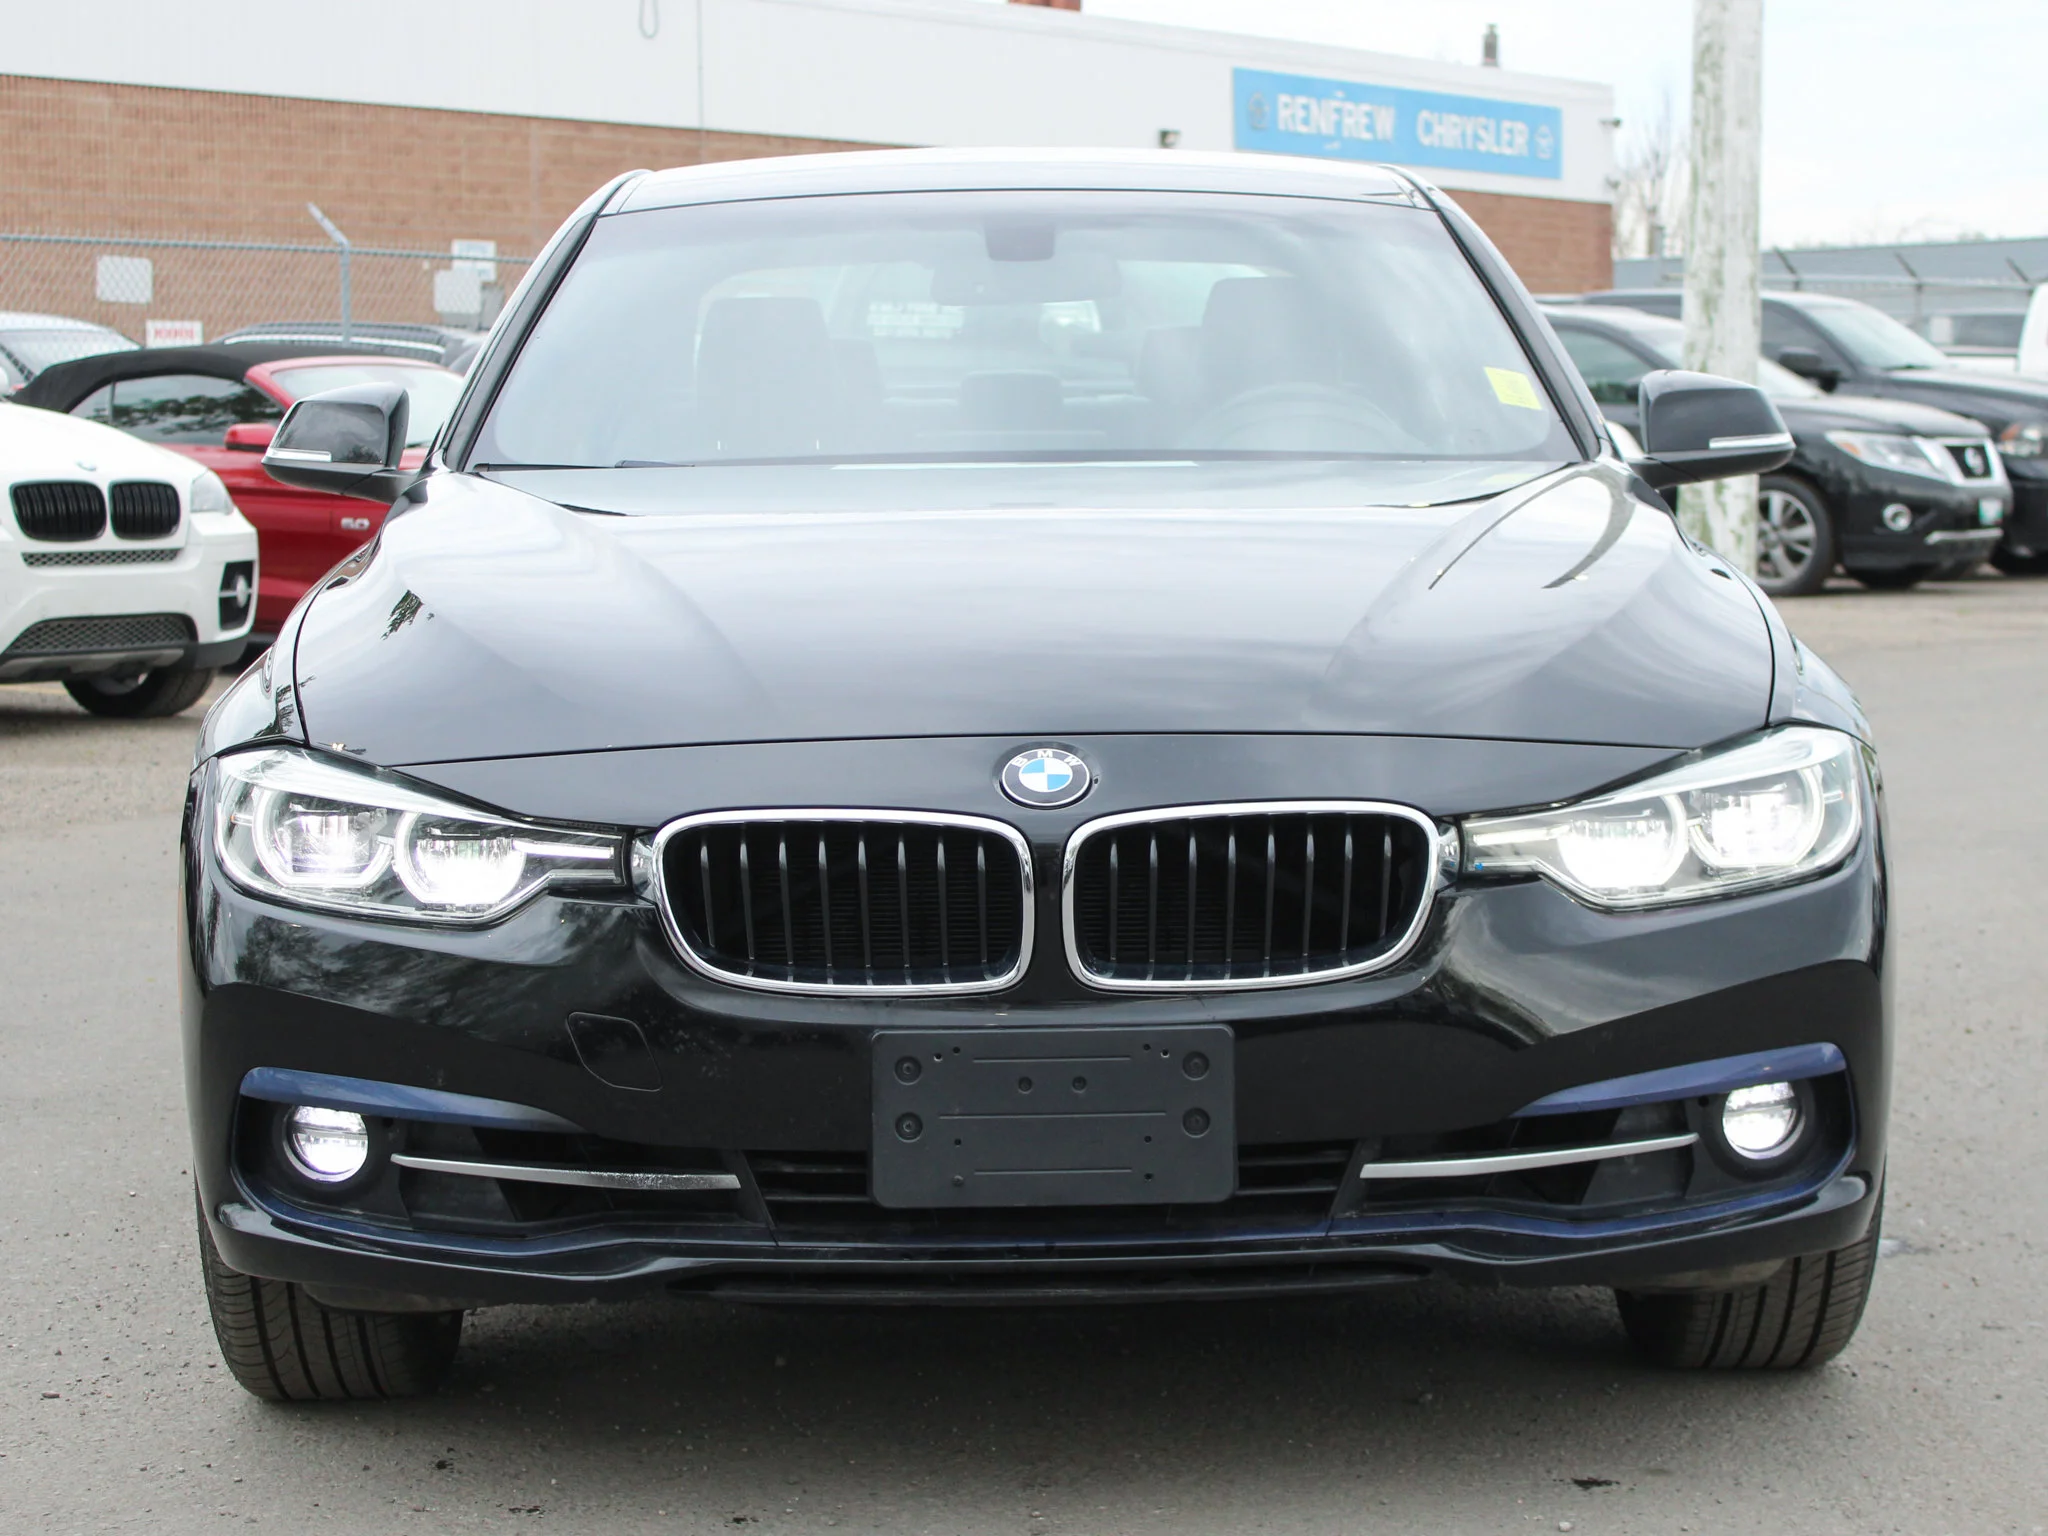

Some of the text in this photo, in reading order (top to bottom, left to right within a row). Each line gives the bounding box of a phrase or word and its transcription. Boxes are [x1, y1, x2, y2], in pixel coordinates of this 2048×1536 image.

[1277, 93, 1530, 157] RENFREW CHRYSLER
[1010, 750, 1081, 768] BMW
